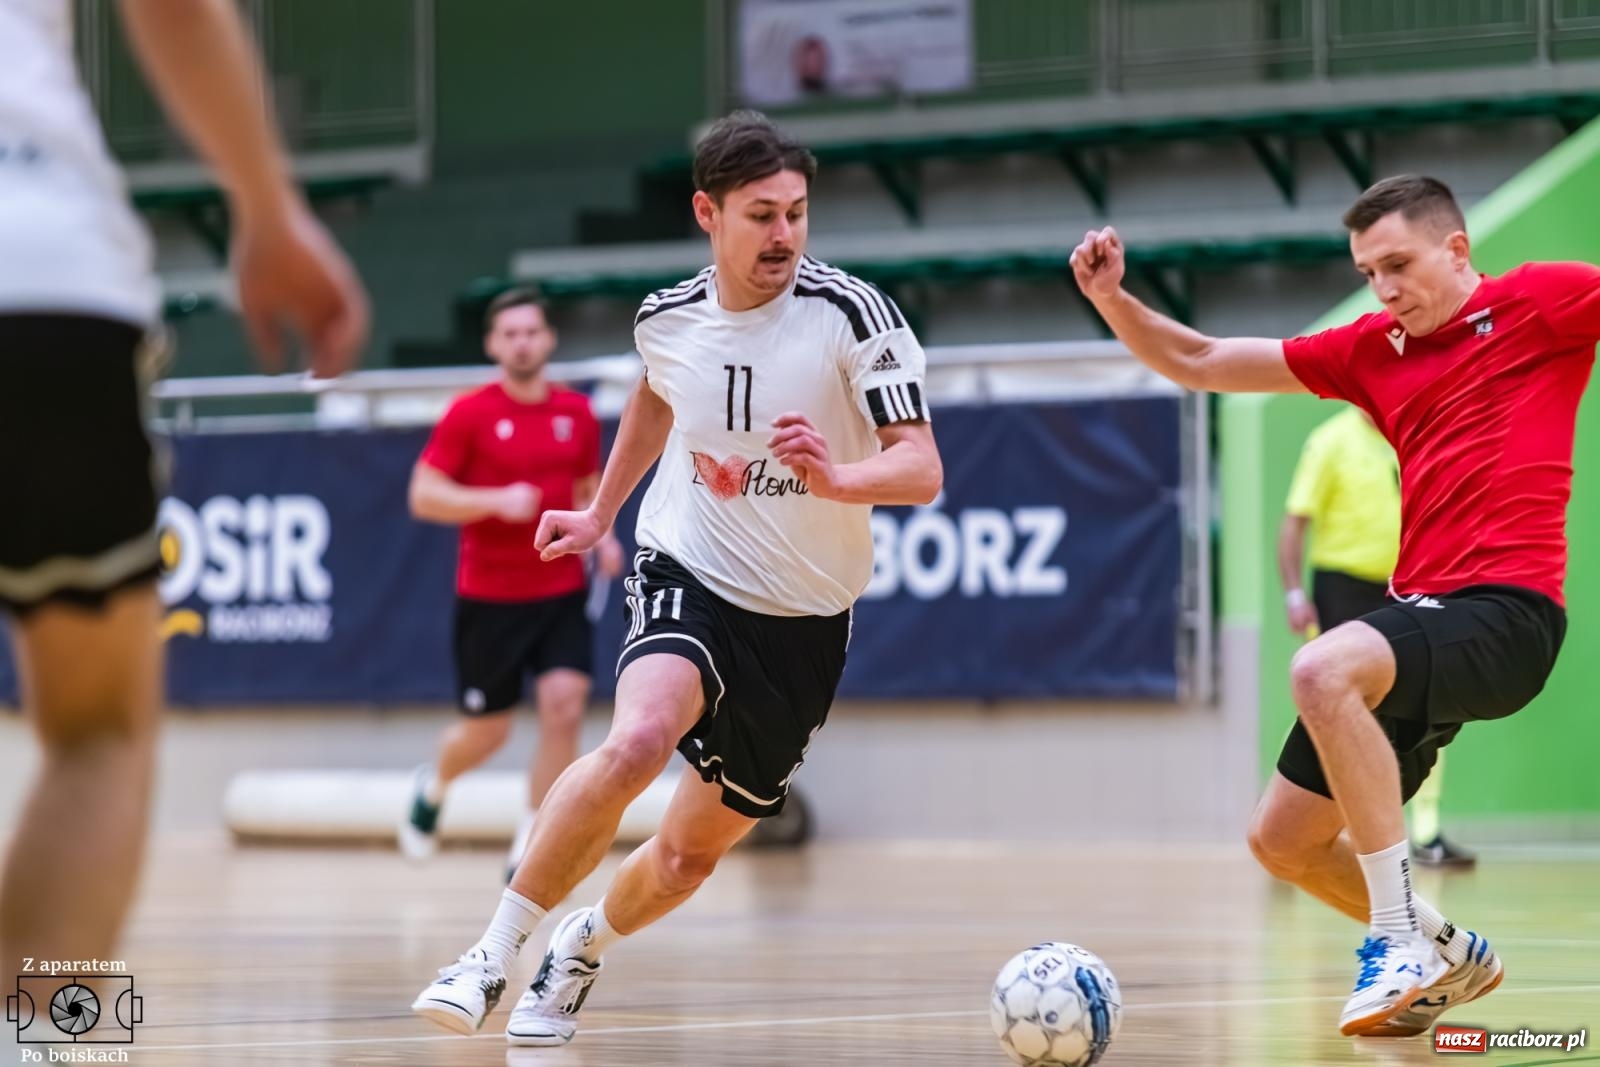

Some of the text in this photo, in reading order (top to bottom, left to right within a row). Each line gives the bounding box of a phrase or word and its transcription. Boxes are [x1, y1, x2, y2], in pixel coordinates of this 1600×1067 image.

[872, 361, 902, 371] adidas
[724, 365, 752, 431] 11
[862, 493, 1068, 599] BÓRZ
[651, 587, 684, 620] 11
